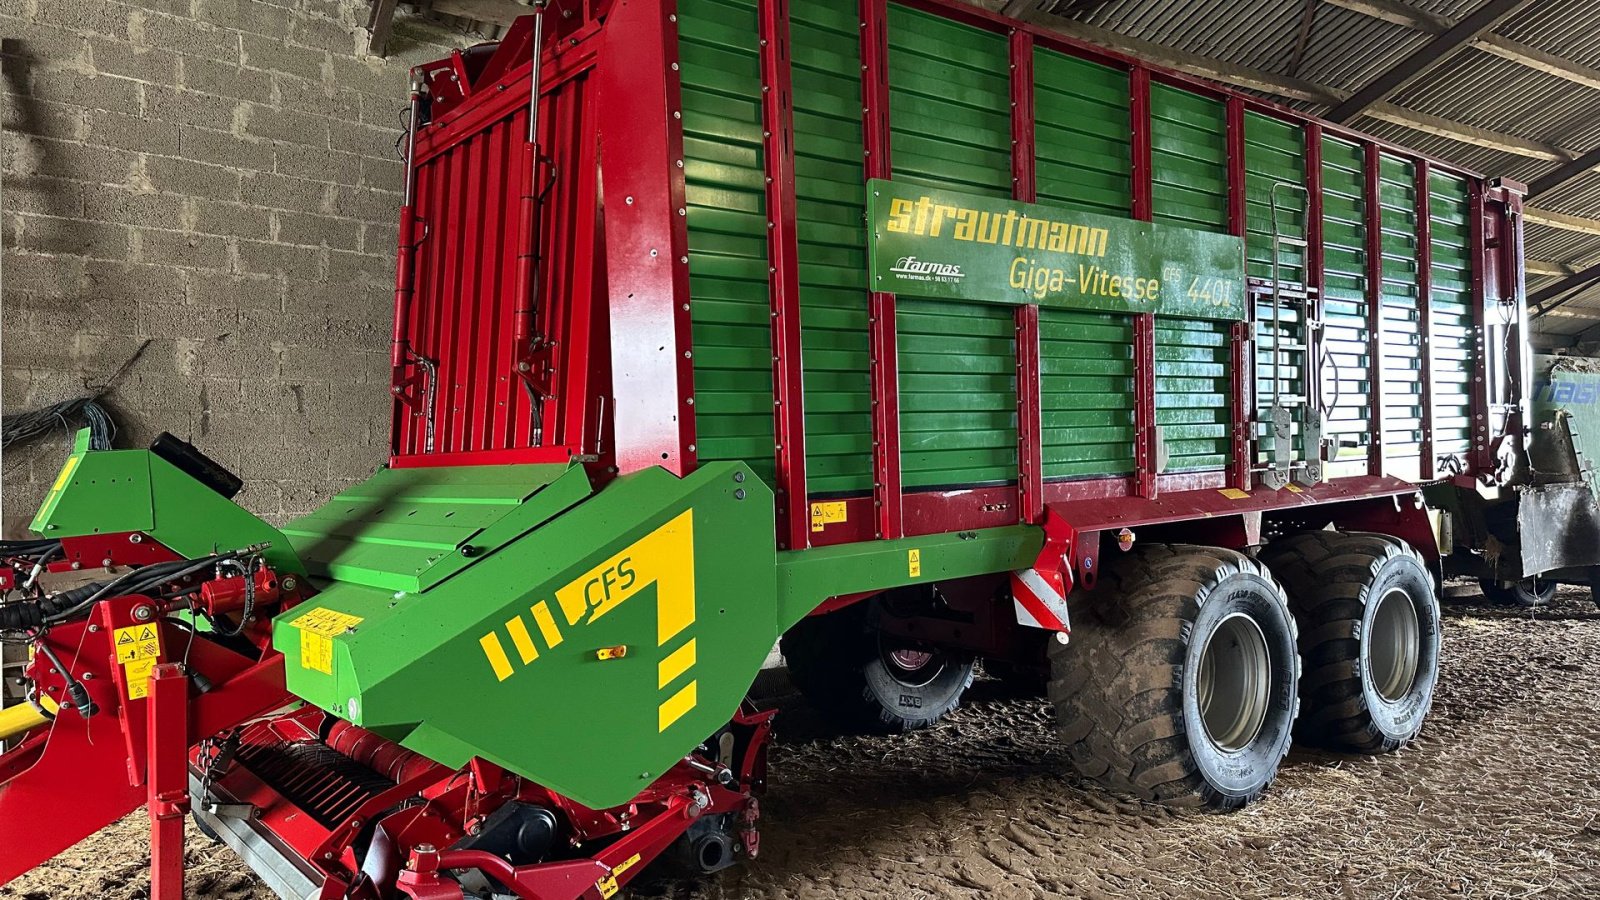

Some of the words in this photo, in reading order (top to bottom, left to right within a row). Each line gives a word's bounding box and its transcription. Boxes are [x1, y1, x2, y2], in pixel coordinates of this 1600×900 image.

[887, 196, 1109, 257] strautmann
[1009, 256, 1159, 300] Giga-Vitesse
[1163, 267, 1181, 282] CFS
[584, 556, 636, 609] CFS
[898, 694, 923, 708] BKT
